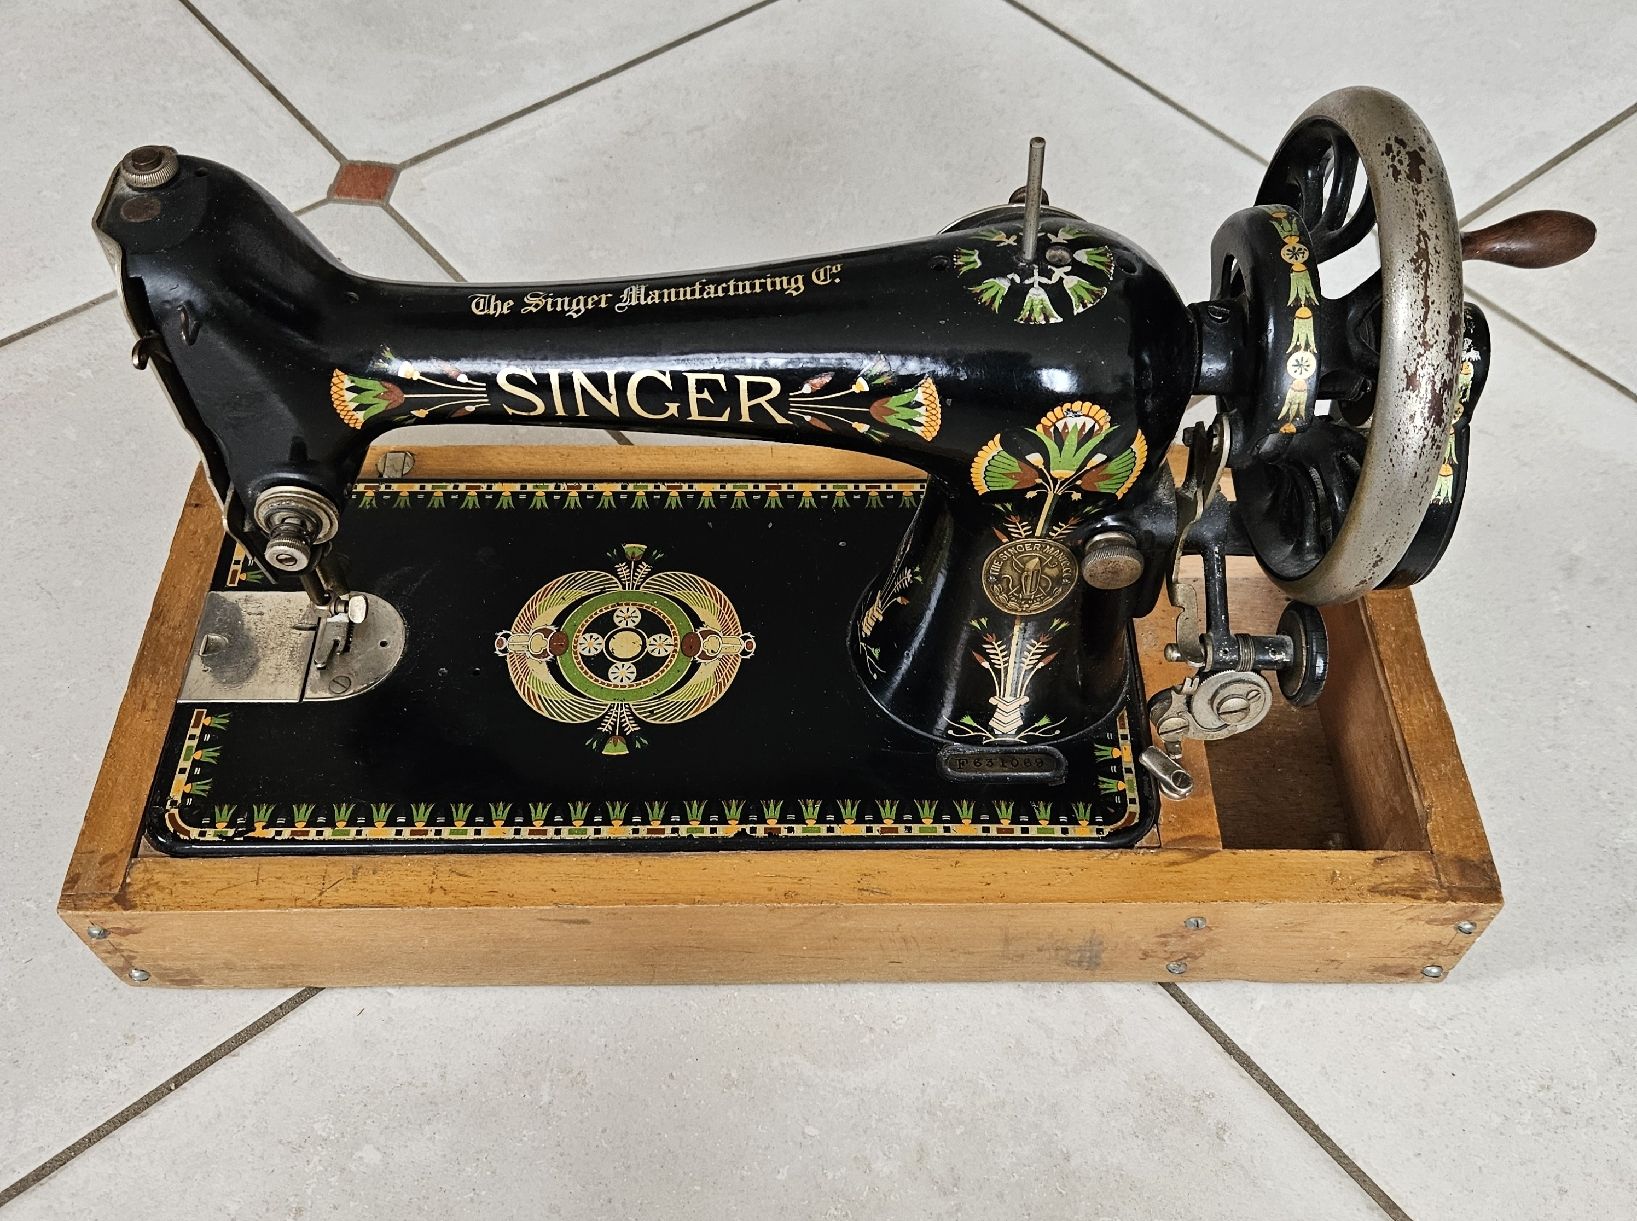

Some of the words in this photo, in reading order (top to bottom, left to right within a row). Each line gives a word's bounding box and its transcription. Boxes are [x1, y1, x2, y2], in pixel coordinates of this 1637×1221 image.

[468, 293, 515, 318] The
[520, 291, 613, 319] Singer
[613, 273, 805, 314] Manufacturing
[495, 366, 794, 426] SINGER
[989, 559, 1004, 576] THE
[999, 543, 1042, 562] SINGER
